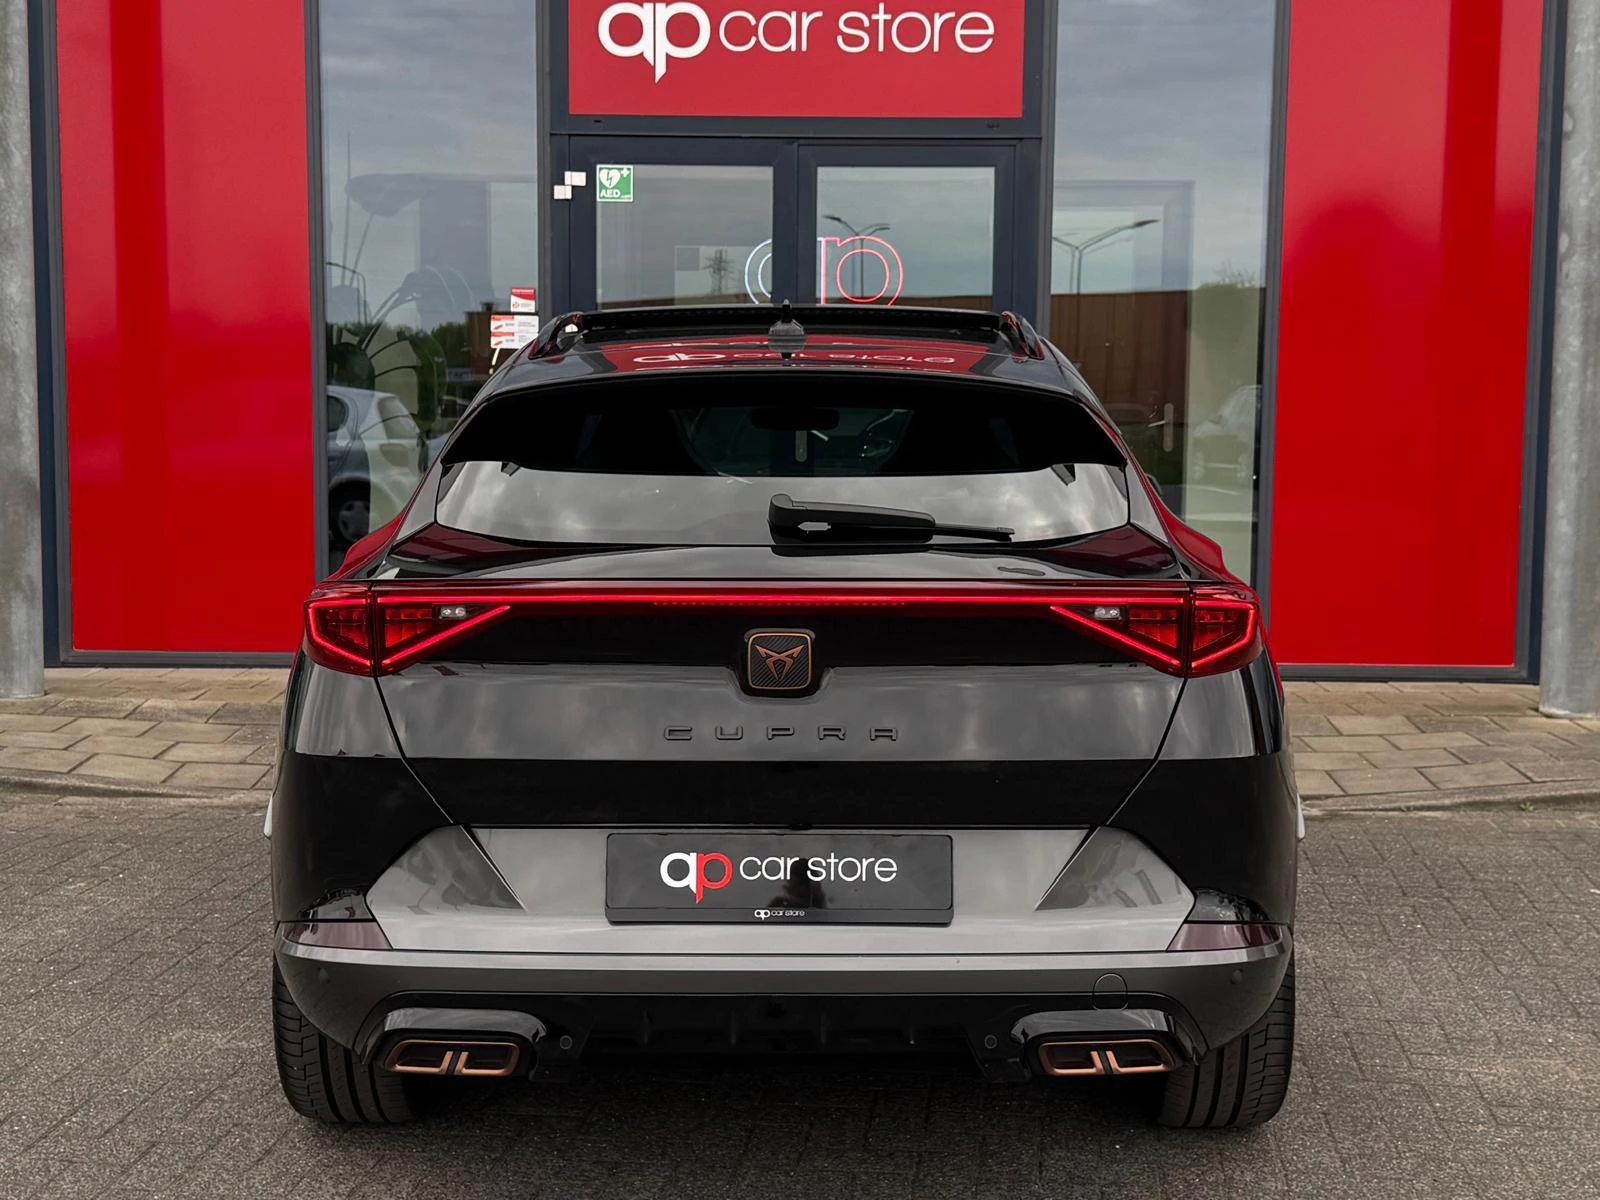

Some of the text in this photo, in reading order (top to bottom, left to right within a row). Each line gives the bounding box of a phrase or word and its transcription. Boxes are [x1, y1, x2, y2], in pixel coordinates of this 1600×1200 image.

[719, 10, 823, 52] car
[837, 2, 995, 53] store
[600, 189, 621, 198] AED
[664, 726, 898, 741] CUPRA
[739, 856, 800, 880] car
[806, 852, 898, 882] store
